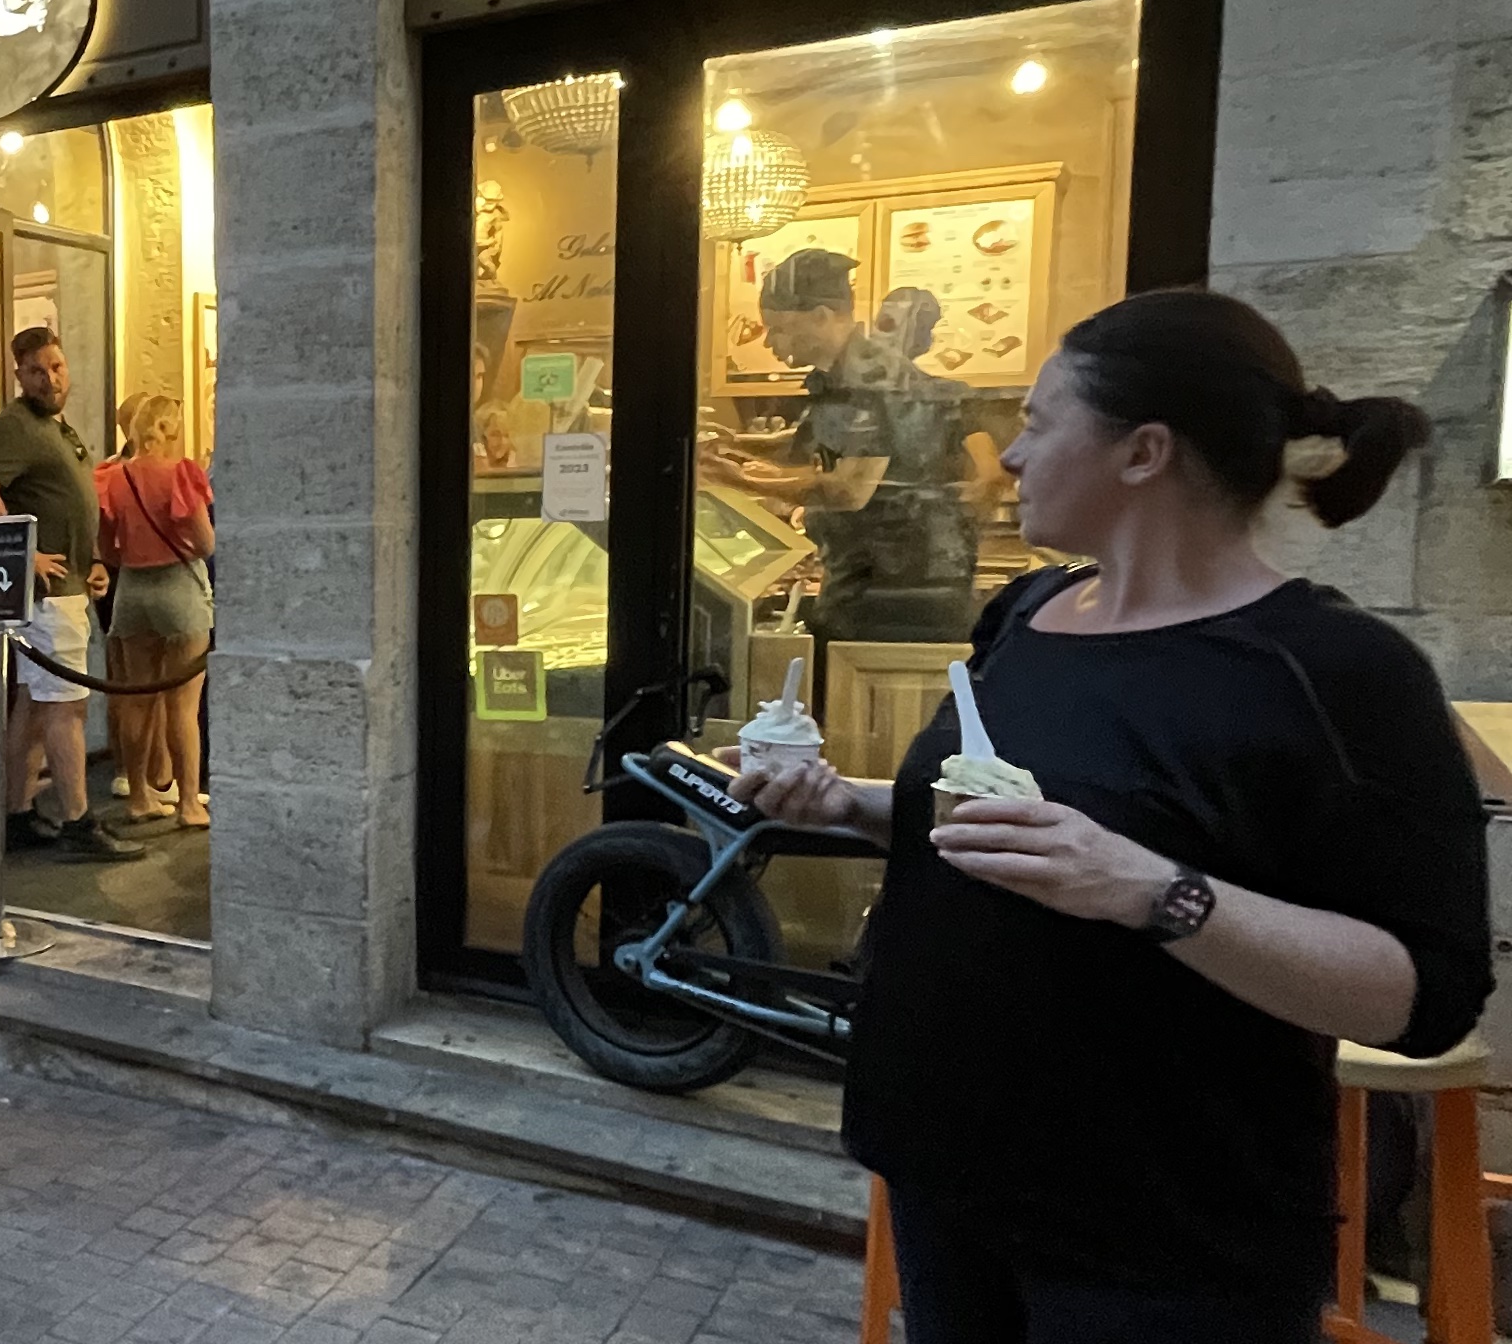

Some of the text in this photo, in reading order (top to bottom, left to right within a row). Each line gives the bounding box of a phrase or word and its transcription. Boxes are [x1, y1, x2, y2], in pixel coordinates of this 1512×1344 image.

[492, 667, 526, 681] Uber
[493, 681, 527, 694] Eats
[668, 763, 743, 814] SUPER73
